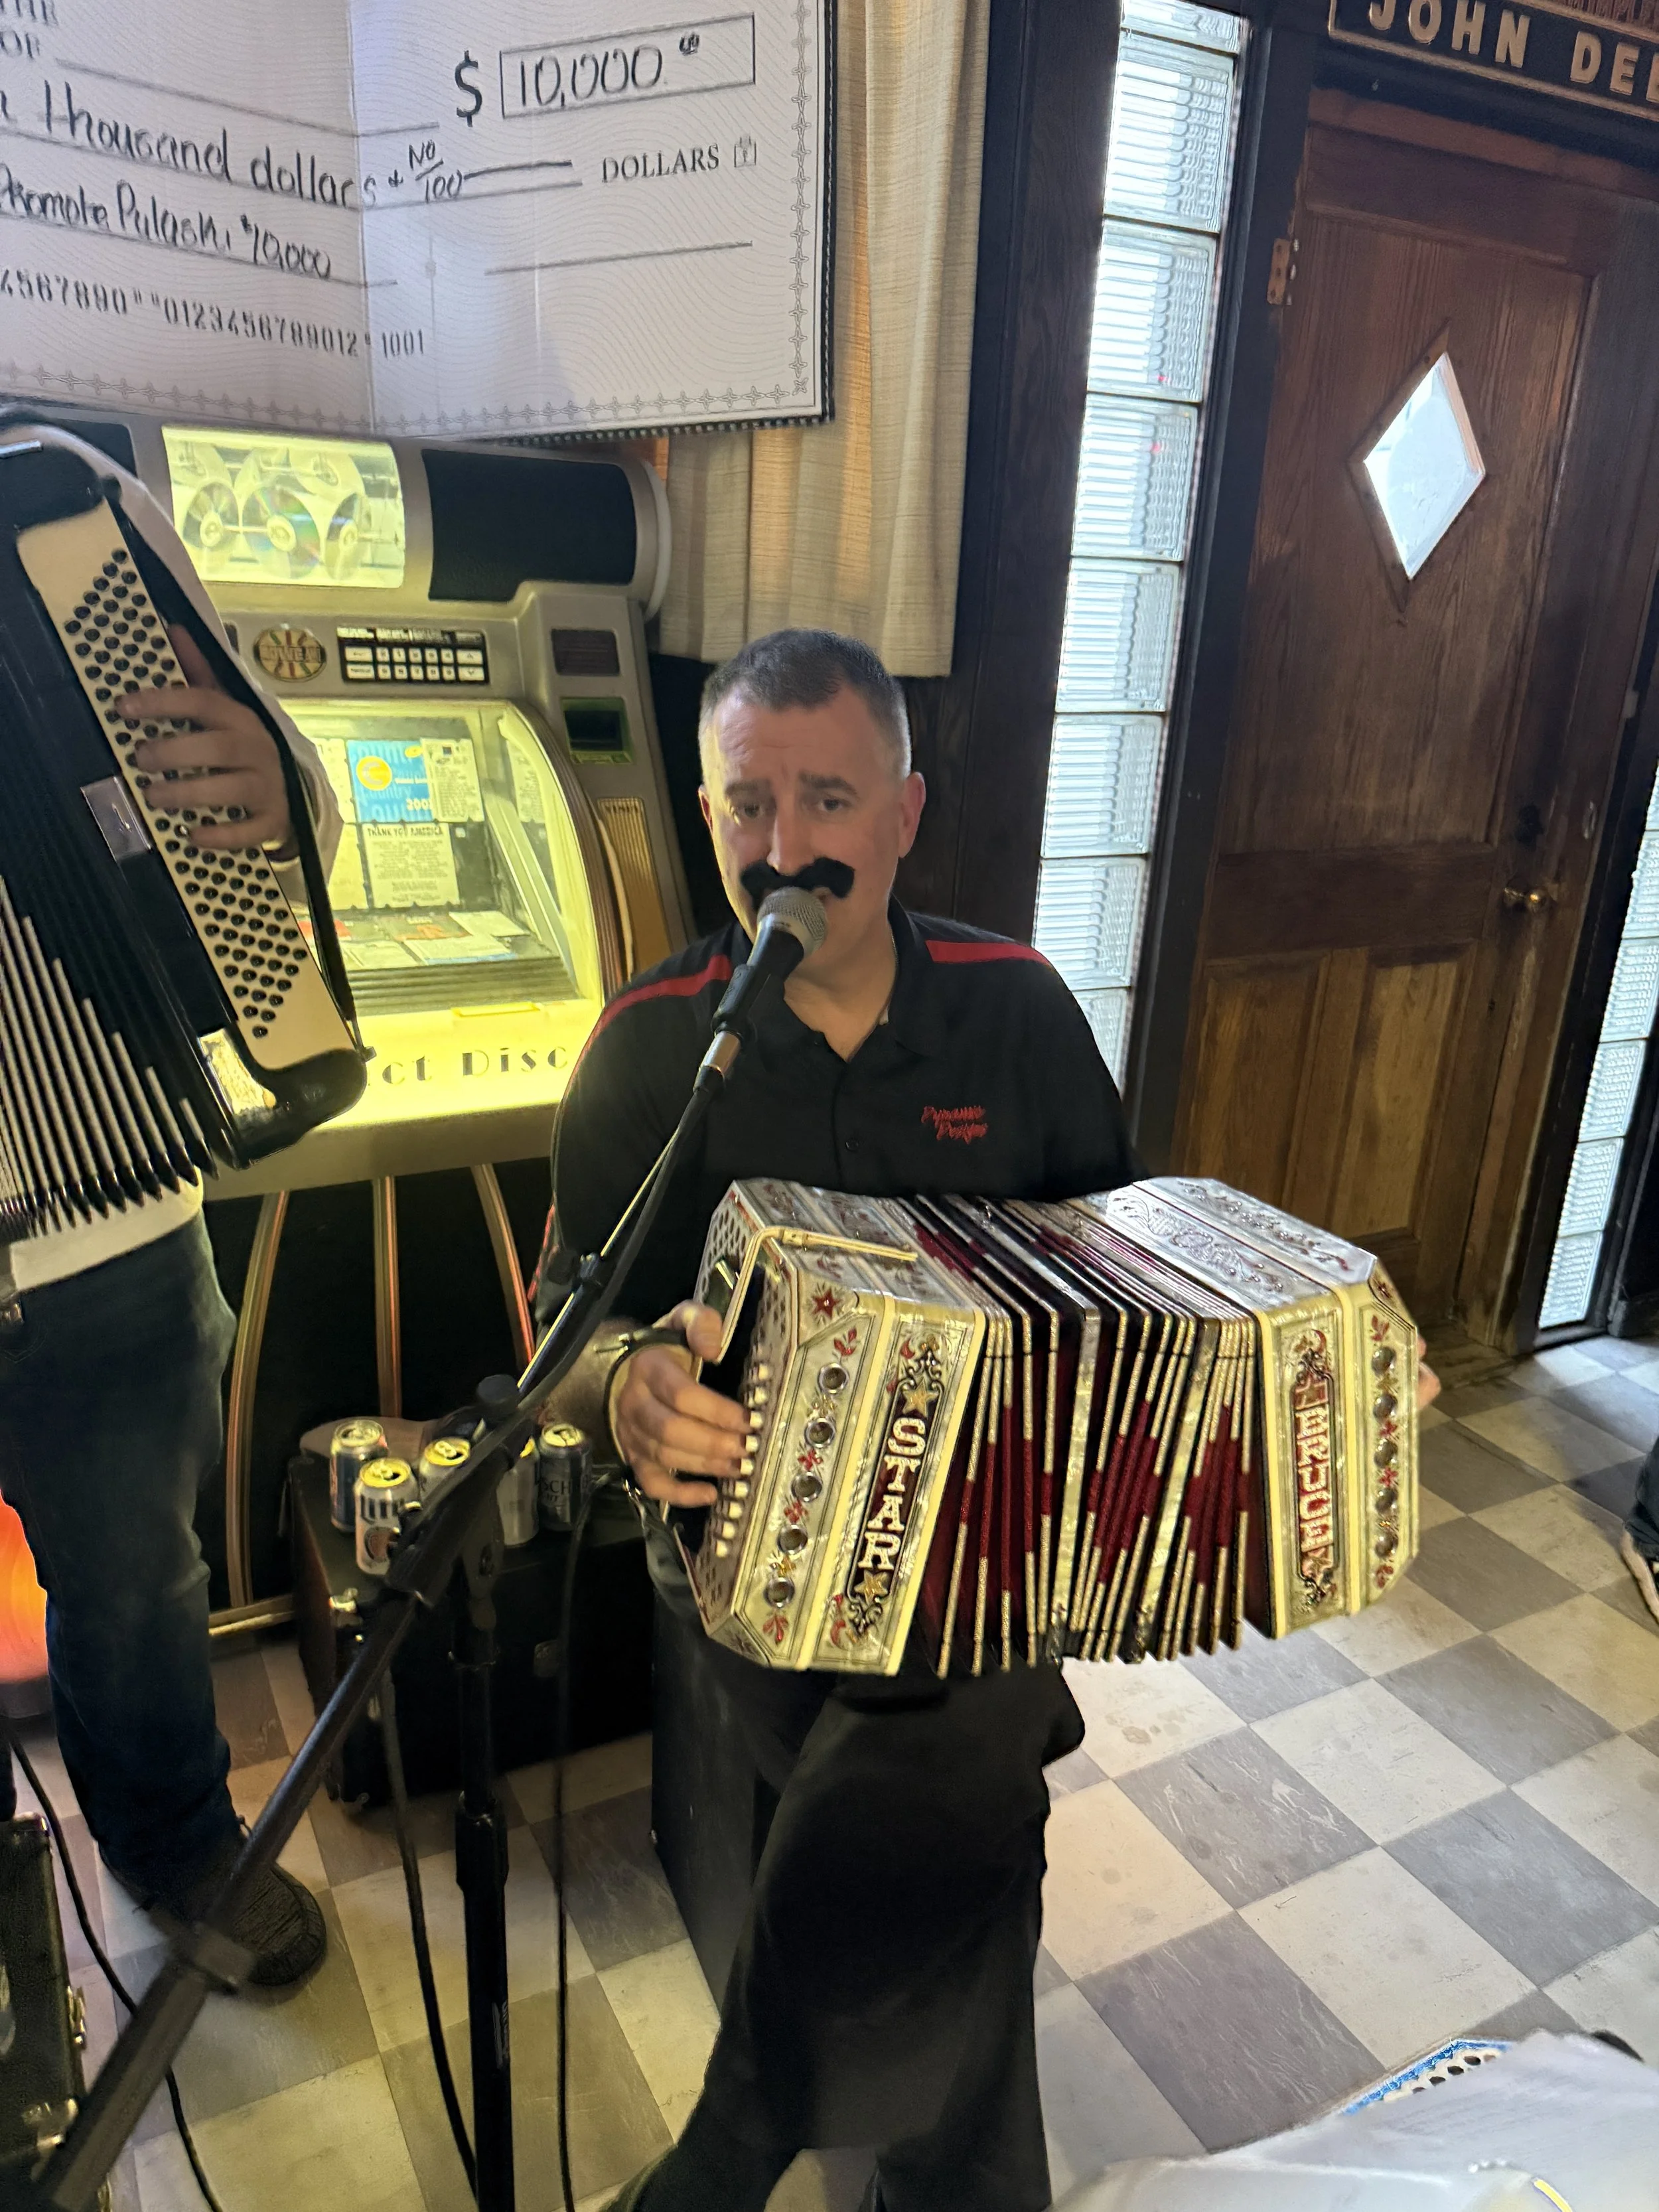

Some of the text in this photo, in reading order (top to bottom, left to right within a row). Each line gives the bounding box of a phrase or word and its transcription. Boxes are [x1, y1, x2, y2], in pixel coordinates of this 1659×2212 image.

[1368, 0, 1530, 68] JOHN
[455, 50, 482, 127] $
[519, 45, 663, 108] 10,000
[601, 143, 721, 183] DOLLARS
[382, 329, 425, 358] 1001
[367, 826, 392, 837] THANK
[462, 1045, 568, 1076] Disc
[857, 1417, 928, 1570] STAR
